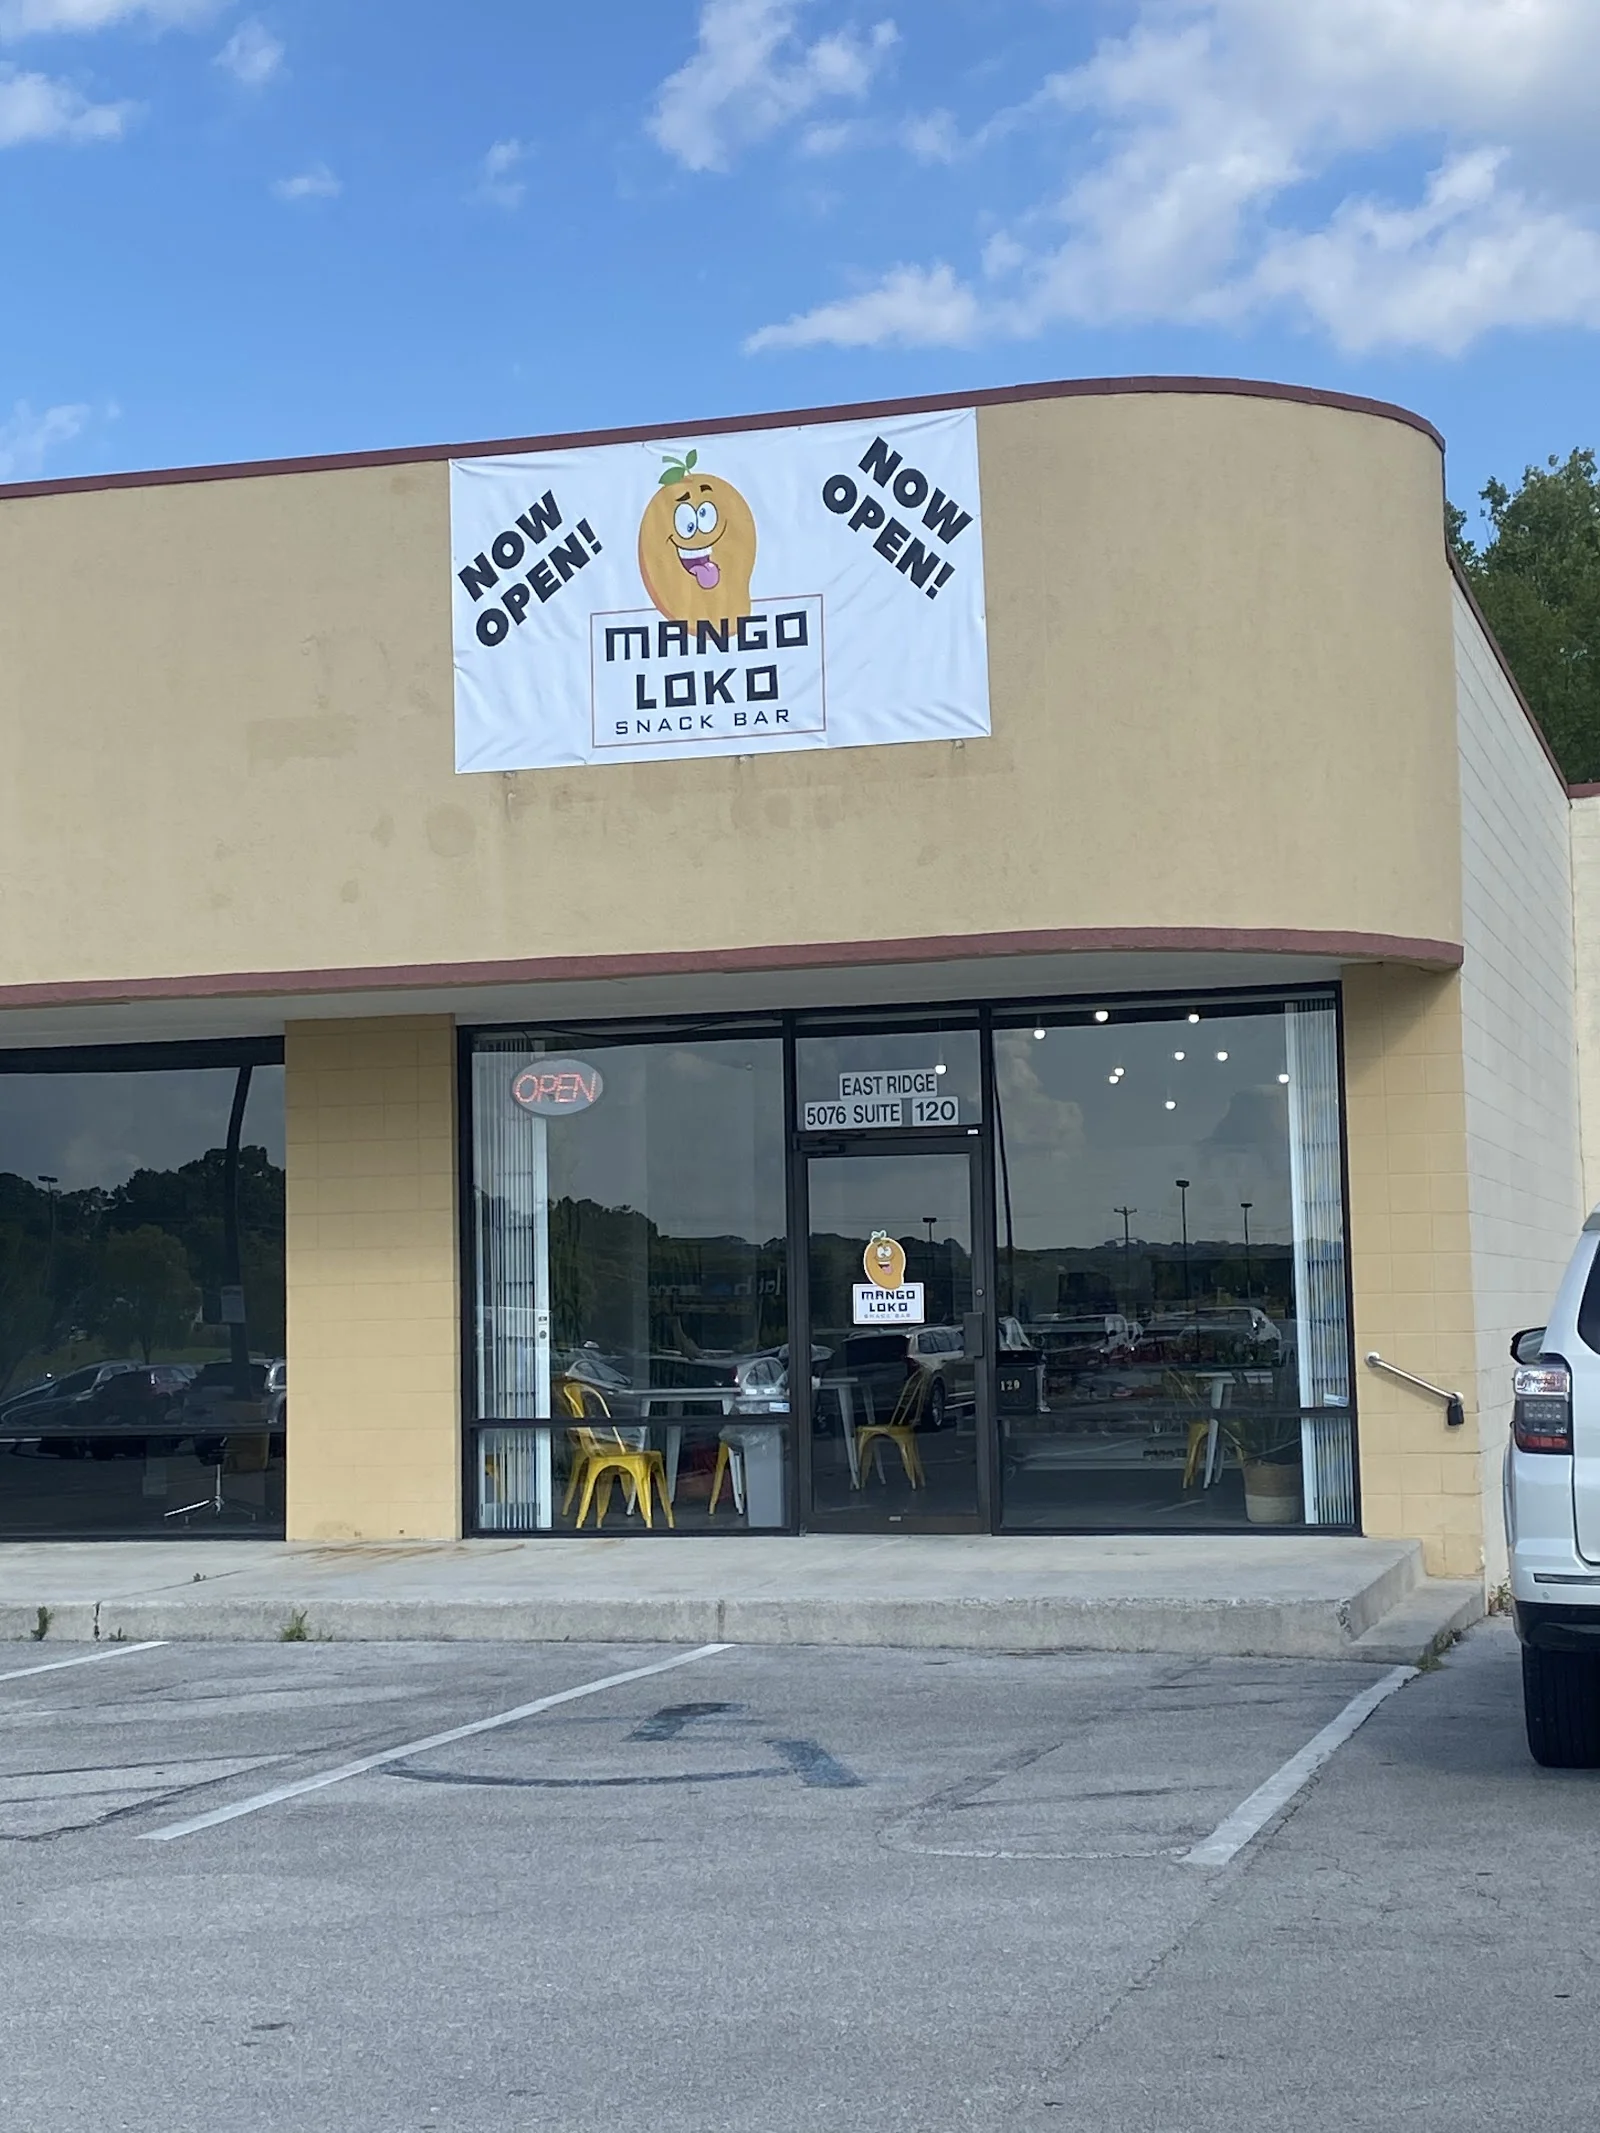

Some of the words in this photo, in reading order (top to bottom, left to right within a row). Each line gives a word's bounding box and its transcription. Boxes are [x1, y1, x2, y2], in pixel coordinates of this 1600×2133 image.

[857, 435, 974, 545] NOW
[457, 489, 563, 602] NOW
[822, 474, 956, 600] OPEN!
[475, 517, 603, 647] OPEN!
[605, 610, 809, 662] MANGO
[636, 664, 779, 710] LOKO
[615, 714, 715, 735] SNACK
[734, 709, 790, 727] BAR
[515, 1071, 597, 1103] OPEN
[842, 1076, 883, 1096] EAST
[887, 1073, 936, 1094] RIDGE
[806, 1105, 847, 1126] 5076
[853, 1103, 900, 1124] SUITE
[914, 1100, 956, 1121] 120
[861, 1290, 916, 1300] MANGO
[869, 1302, 908, 1312] LOKO
[1000, 1379, 1020, 1391] 120
